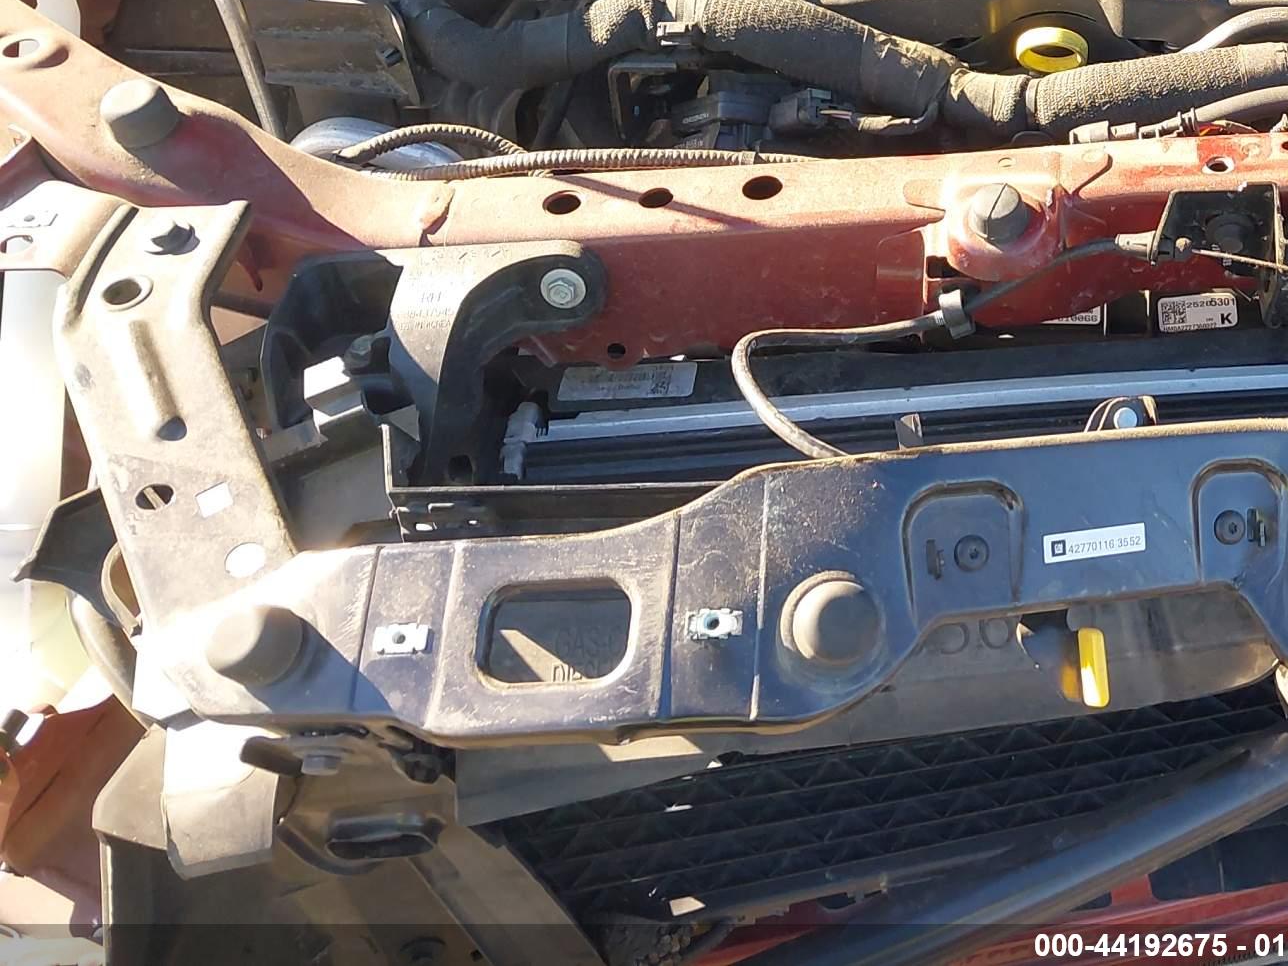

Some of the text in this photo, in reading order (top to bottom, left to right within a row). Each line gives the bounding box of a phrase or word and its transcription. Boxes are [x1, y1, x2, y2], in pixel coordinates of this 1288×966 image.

[1220, 312, 1234, 325] K
[1068, 538, 1115, 554] 42770116
[1117, 536, 1141, 549] 3552
